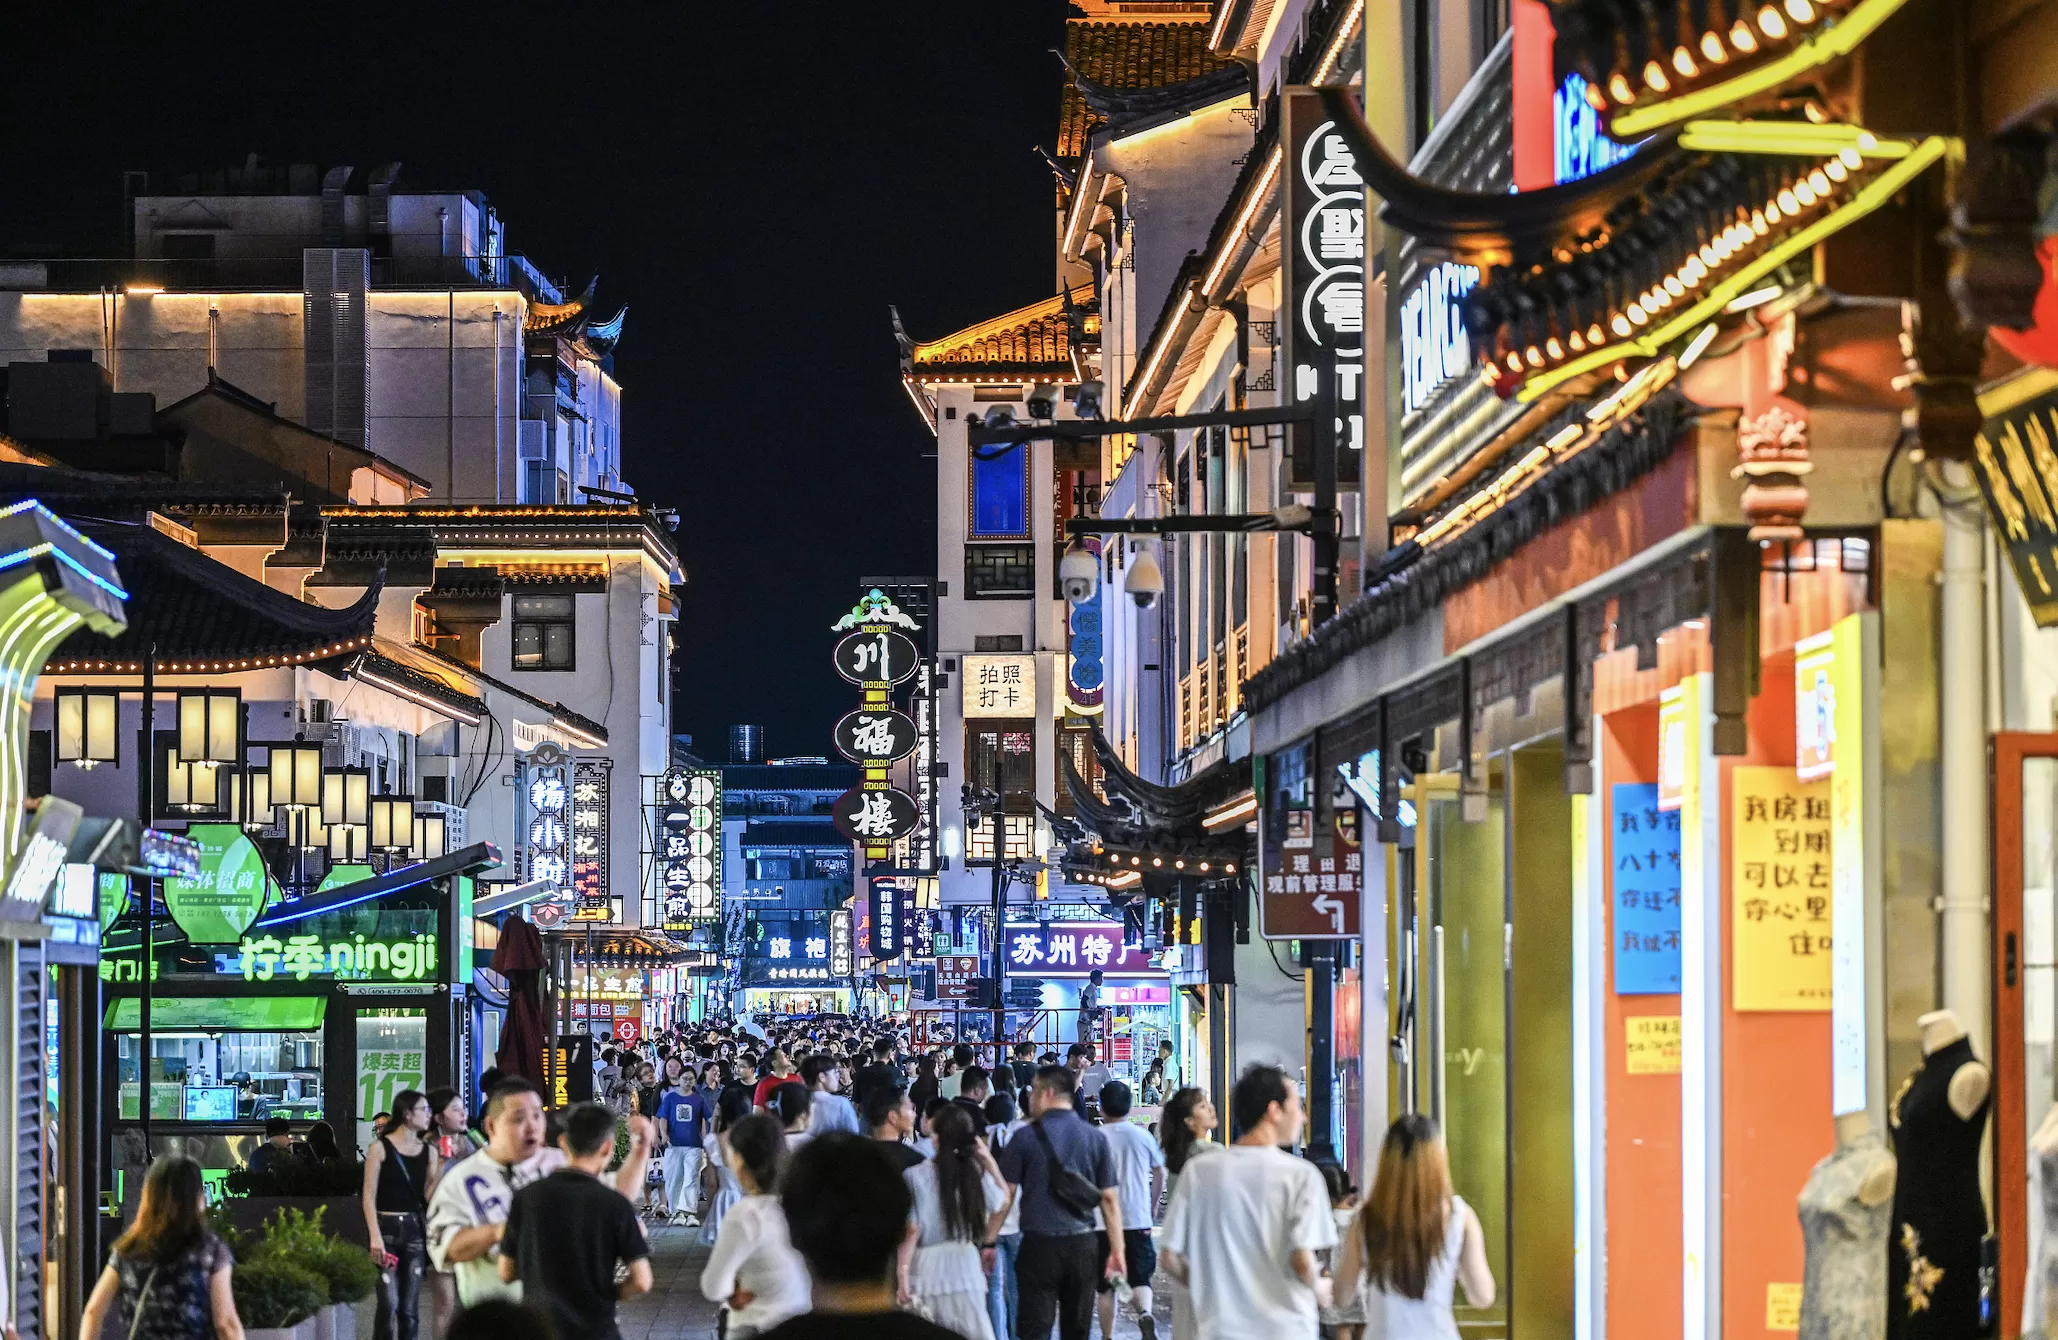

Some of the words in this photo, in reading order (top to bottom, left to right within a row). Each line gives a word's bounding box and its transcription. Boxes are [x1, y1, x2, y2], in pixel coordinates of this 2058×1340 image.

[980, 664, 1021, 685] 拍照
[979, 687, 1020, 708] 打卡
[664, 812, 691, 918] 一品生煎
[1278, 852, 1361, 874] 理由退
[1267, 873, 1361, 895] 观前管理服
[1743, 860, 1829, 889] 可以去
[1742, 896, 1829, 922] 你心里
[239, 934, 325, 981] 柠季
[330, 934, 436, 979] ningji
[769, 937, 827, 959] 旗袍
[570, 975, 644, 993] 一品生煎
[361, 1052, 422, 1071] 爆卖超
